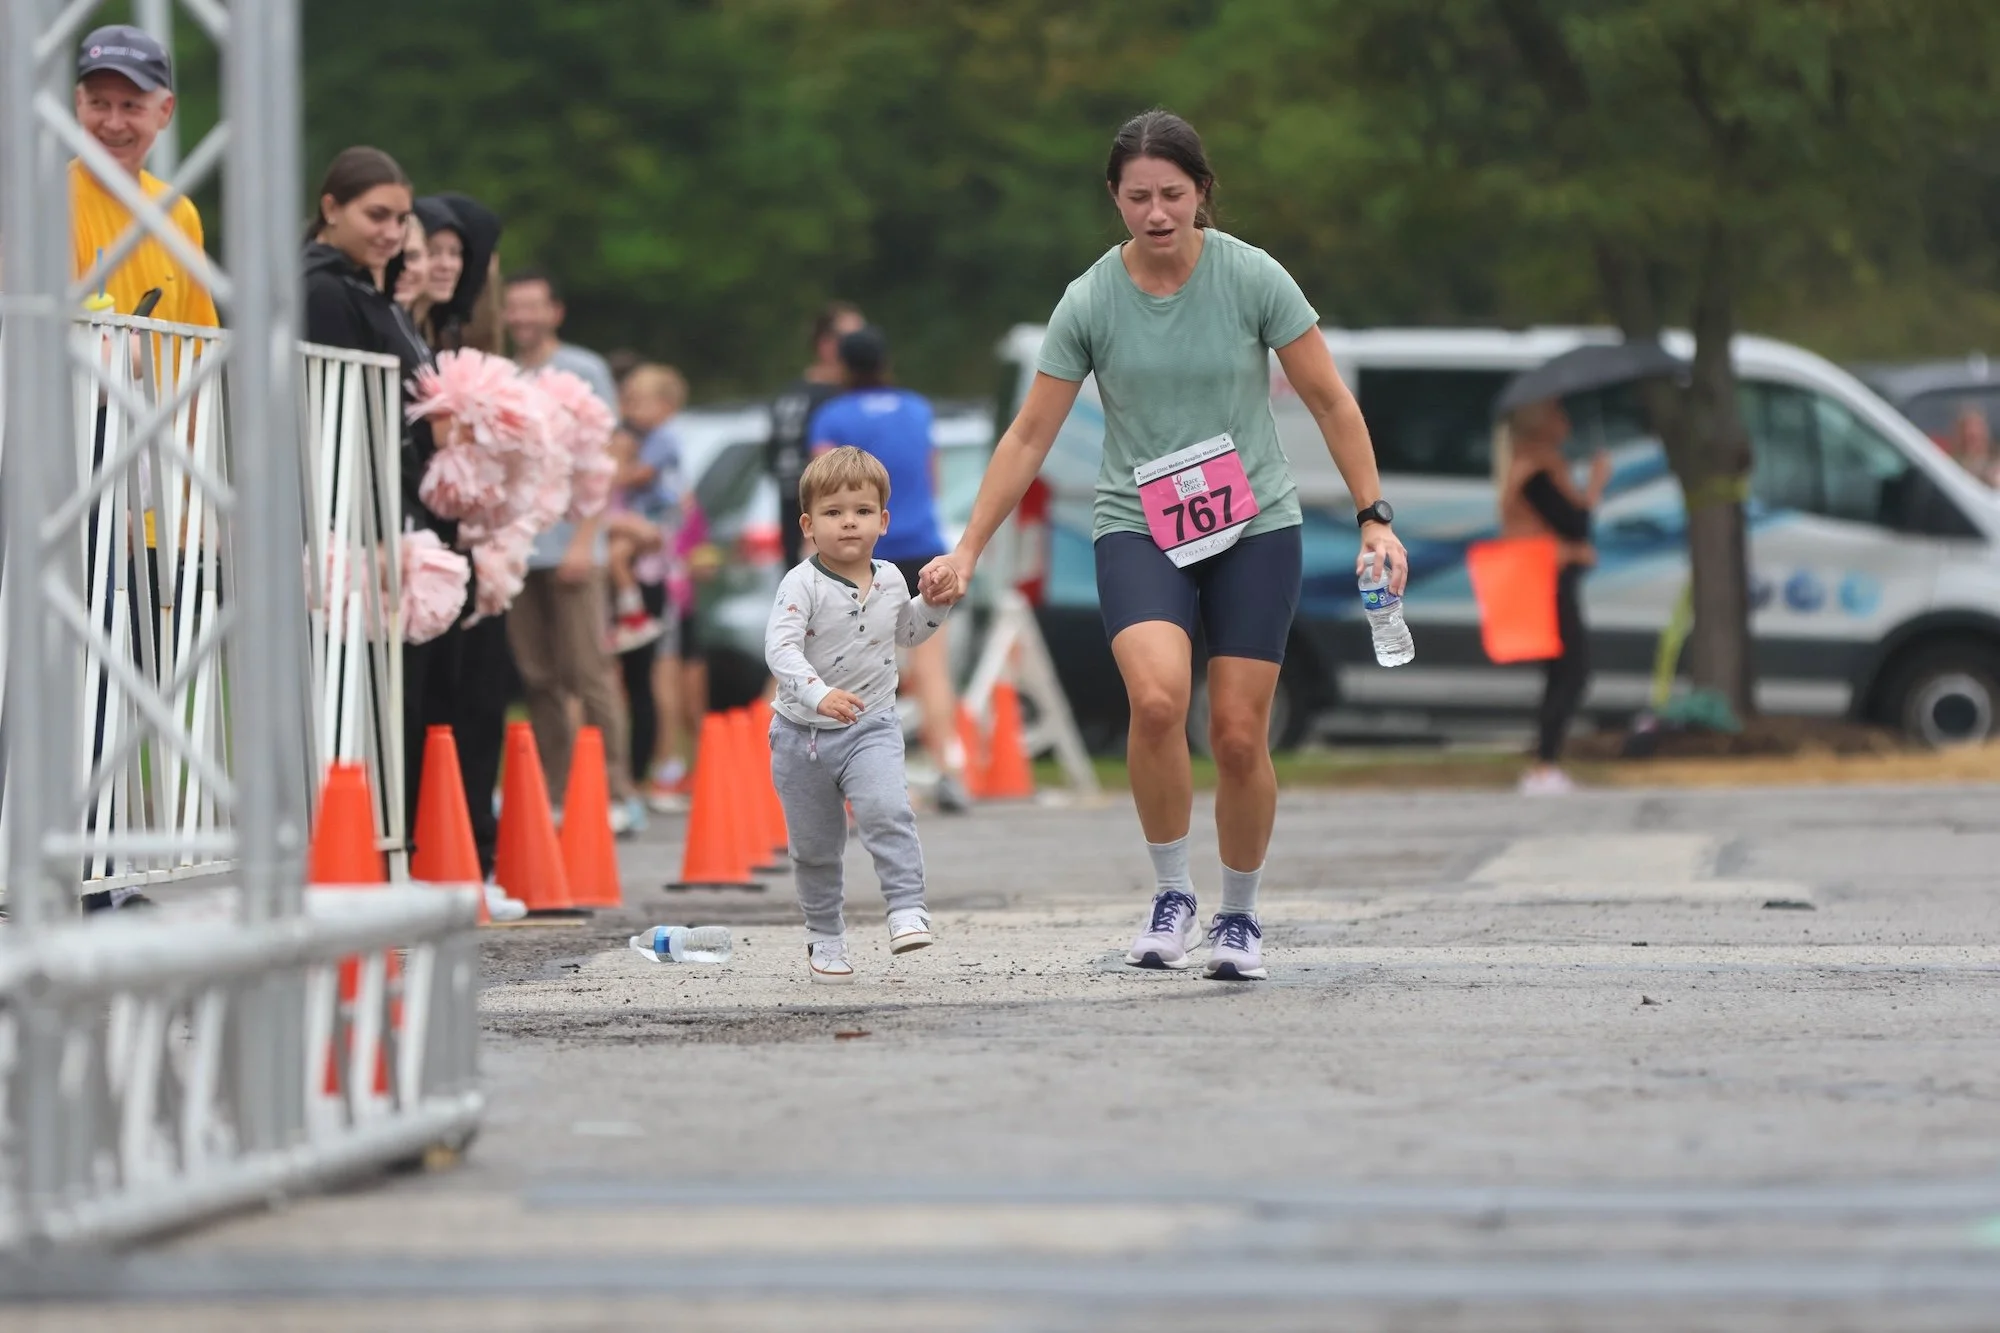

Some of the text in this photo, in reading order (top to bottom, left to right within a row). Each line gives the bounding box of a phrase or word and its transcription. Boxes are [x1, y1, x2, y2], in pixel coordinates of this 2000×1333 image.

[1139, 442, 1231, 481] Cleveland Clinic Medina Hospital Medical Staff
[1180, 481, 1203, 494] Grace
[1183, 477, 1199, 488] Race
[1162, 485, 1233, 542] 767
